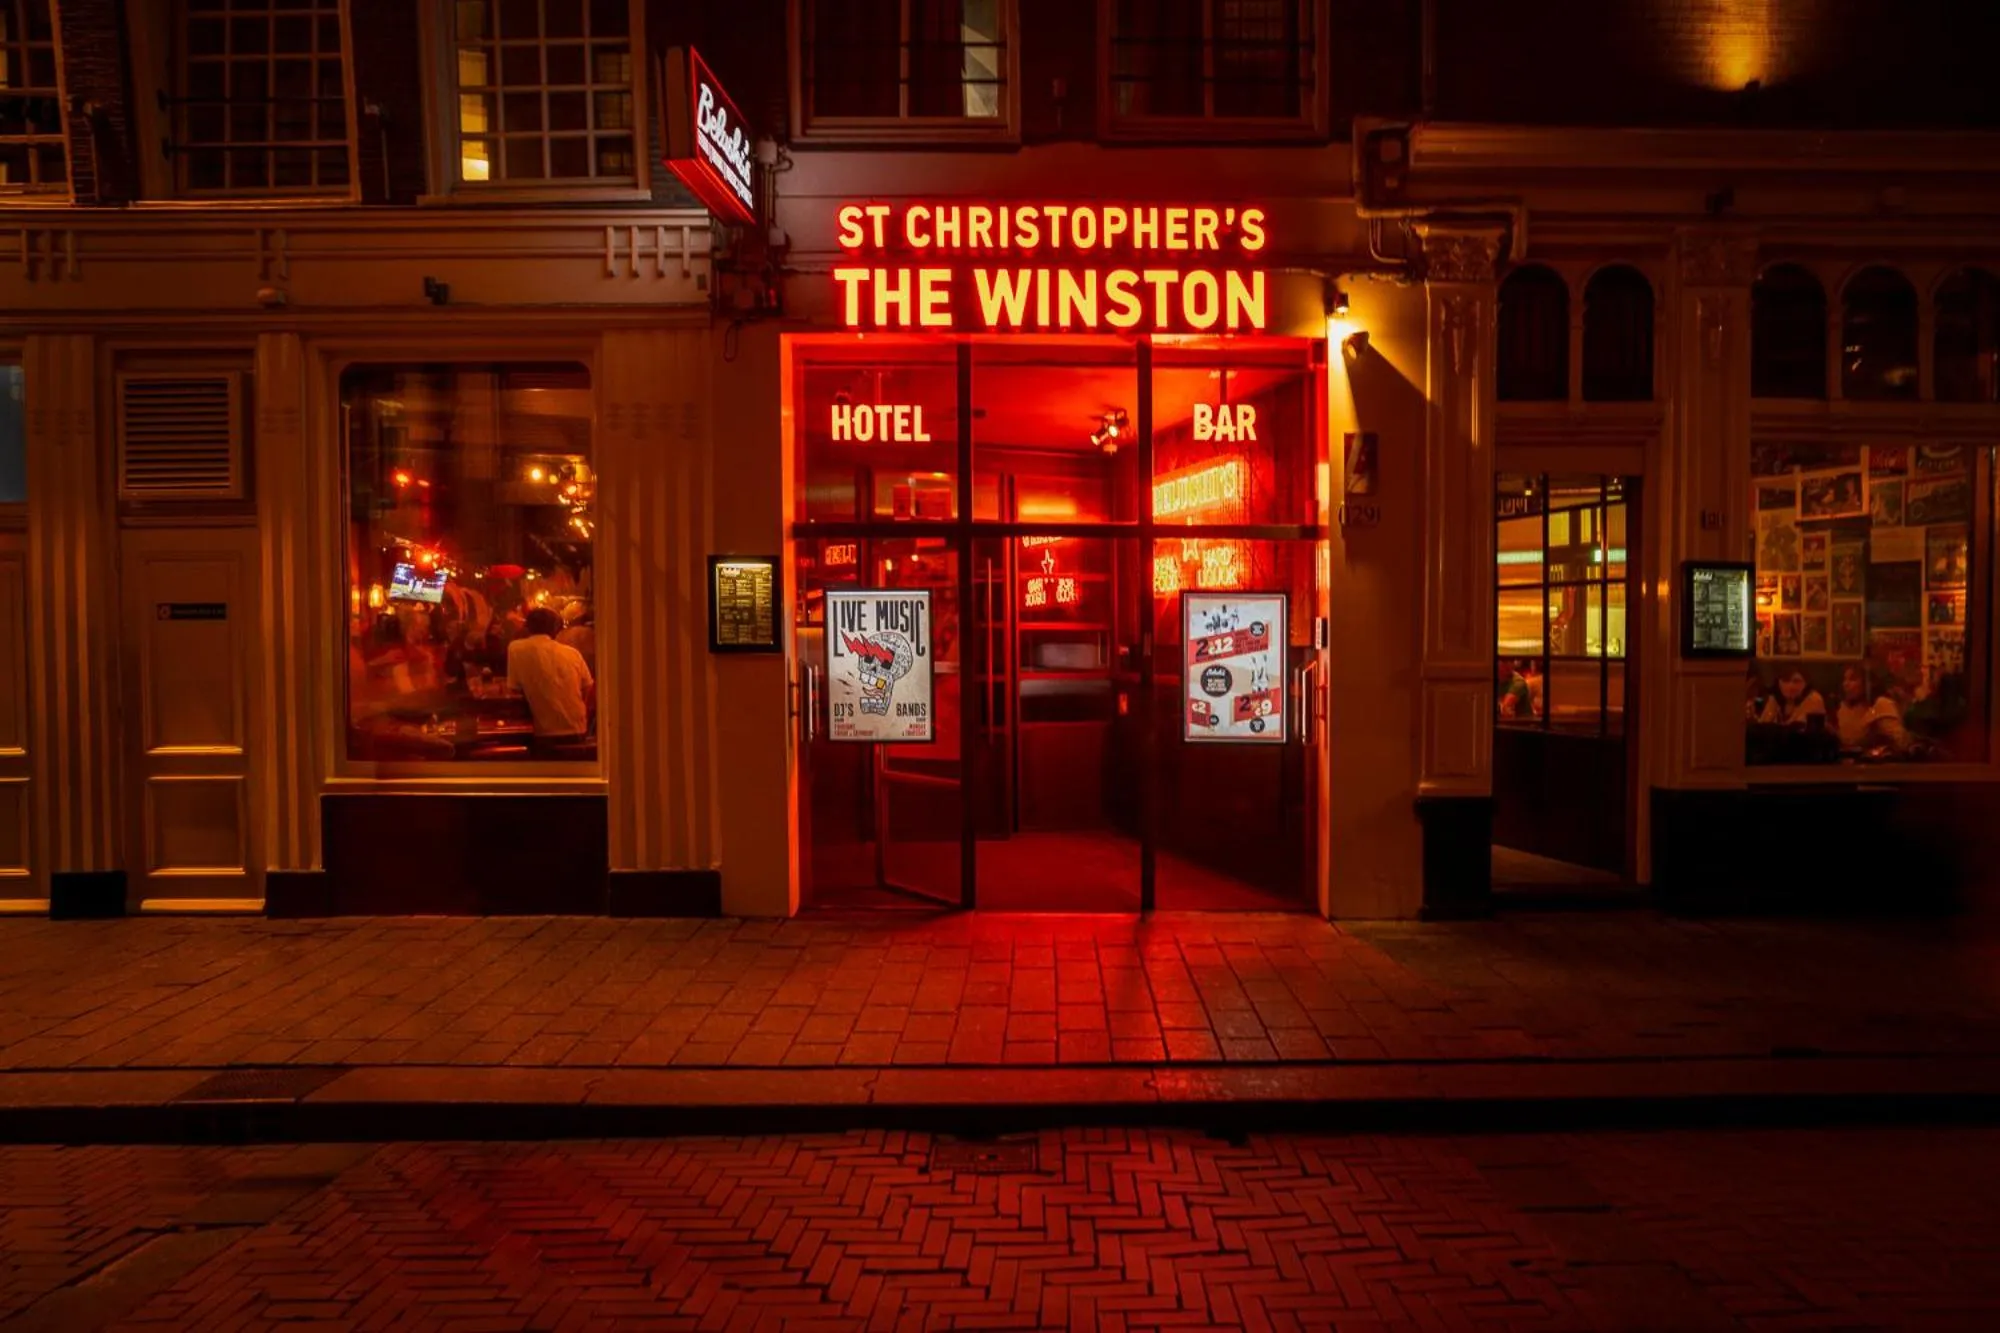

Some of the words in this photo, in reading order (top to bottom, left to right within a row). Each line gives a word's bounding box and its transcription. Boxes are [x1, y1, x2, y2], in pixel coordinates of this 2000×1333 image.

[838, 206, 890, 247] ST
[906, 206, 1265, 250] CHRISTOPHER'S
[833, 268, 952, 326] THE
[974, 268, 1265, 329] WINSTON
[831, 404, 931, 442] HOTEL
[1193, 403, 1257, 442] BAR
[833, 600, 866, 657] LIVE
[876, 600, 926, 657] MUSIC
[834, 703, 854, 716] DJ'S
[896, 703, 926, 716] BANDS
